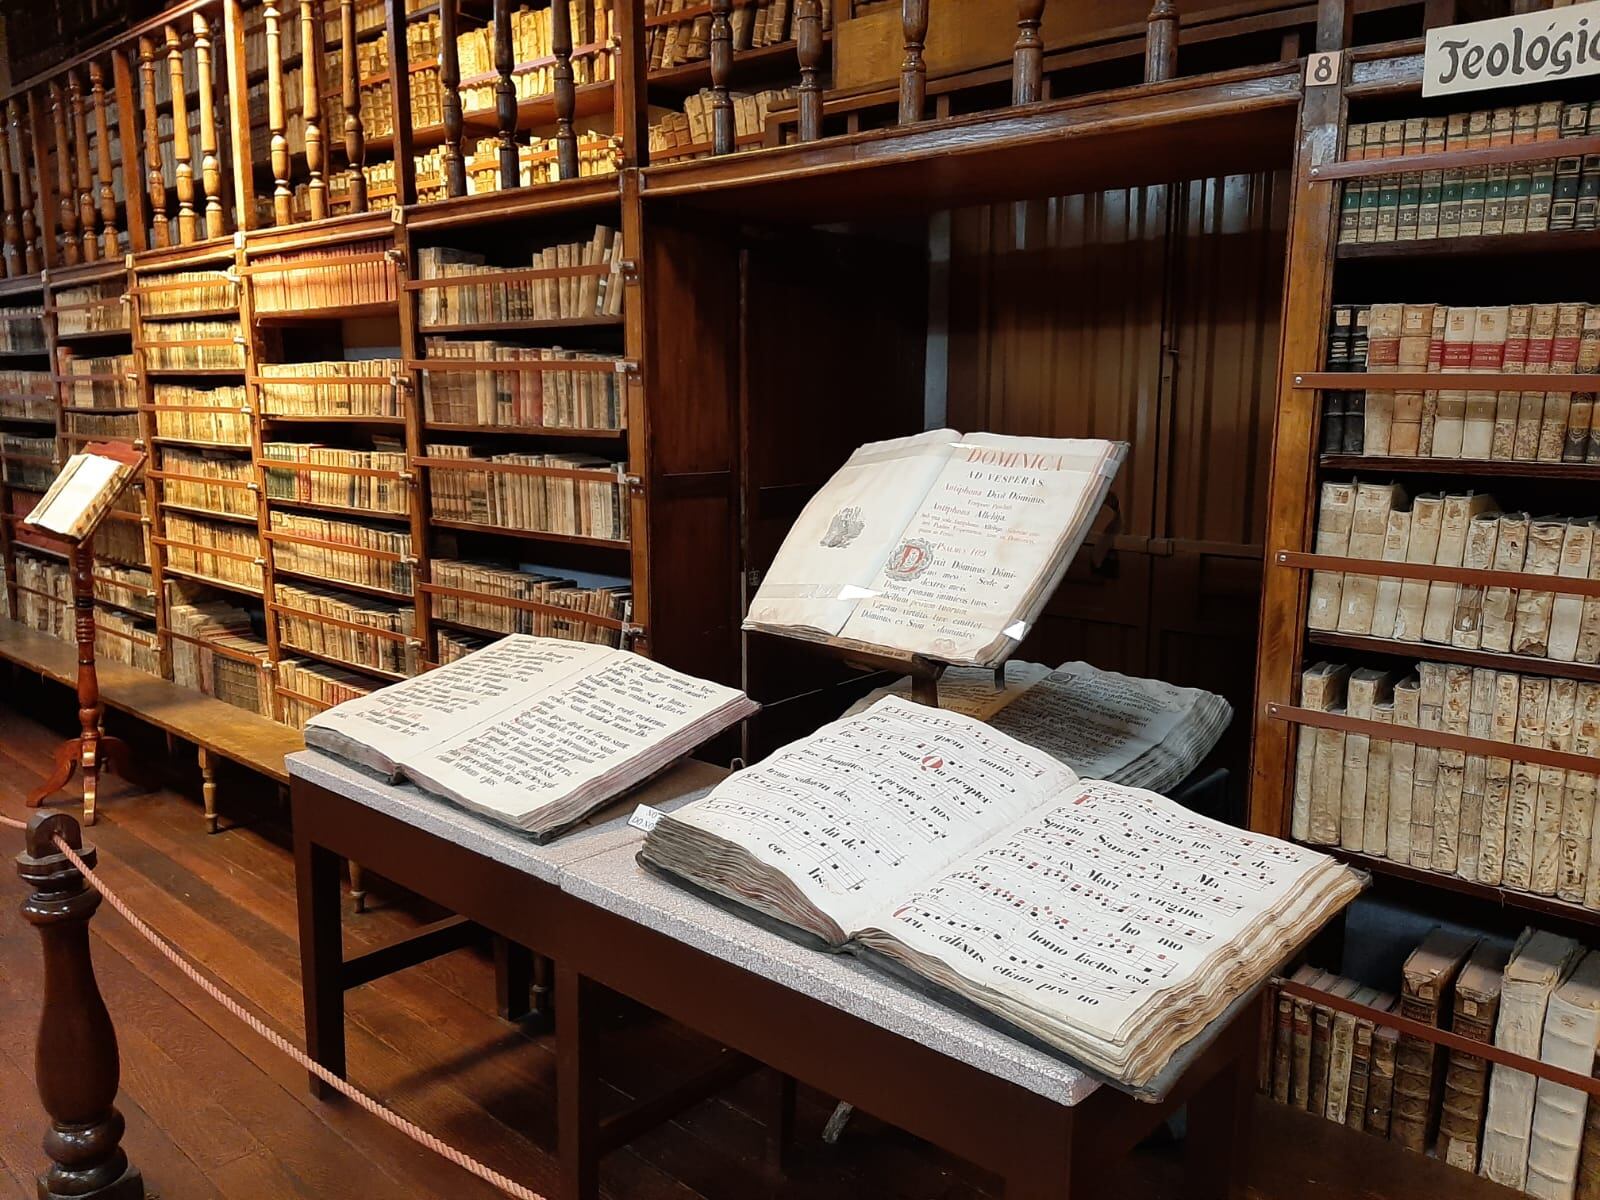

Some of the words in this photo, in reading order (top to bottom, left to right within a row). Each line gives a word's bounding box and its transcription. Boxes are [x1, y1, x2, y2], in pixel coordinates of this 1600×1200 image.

[1314, 56, 1332, 82] 8
[967, 449, 1062, 471] DOMINICA
[933, 734, 965, 749] quem
[945, 776, 993, 804] propter
[929, 805, 950, 821] nos
[821, 826, 840, 838] dit
[1117, 811, 1133, 820] in
[1144, 824, 1183, 844] carna
[1219, 849, 1242, 859] est
[1250, 860, 1270, 869] de
[1039, 817, 1084, 836] Spiritu
[1095, 834, 1141, 858] Sancto
[1149, 861, 1164, 871] ex
[1199, 873, 1219, 888] Ma
[807, 866, 825, 887] lis.
[1059, 859, 1073, 871] ex
[1088, 869, 1122, 890] Mari
[1147, 896, 1203, 918] virgine
[1119, 921, 1140, 936] ho
[1157, 937, 1183, 950] mo
[1027, 929, 1067, 955] homo
[1074, 952, 1118, 974] factus
[1124, 974, 1149, 986] est.
[992, 965, 1033, 983] etiam
[1035, 982, 1069, 994] pro
[1076, 994, 1099, 1005] no
